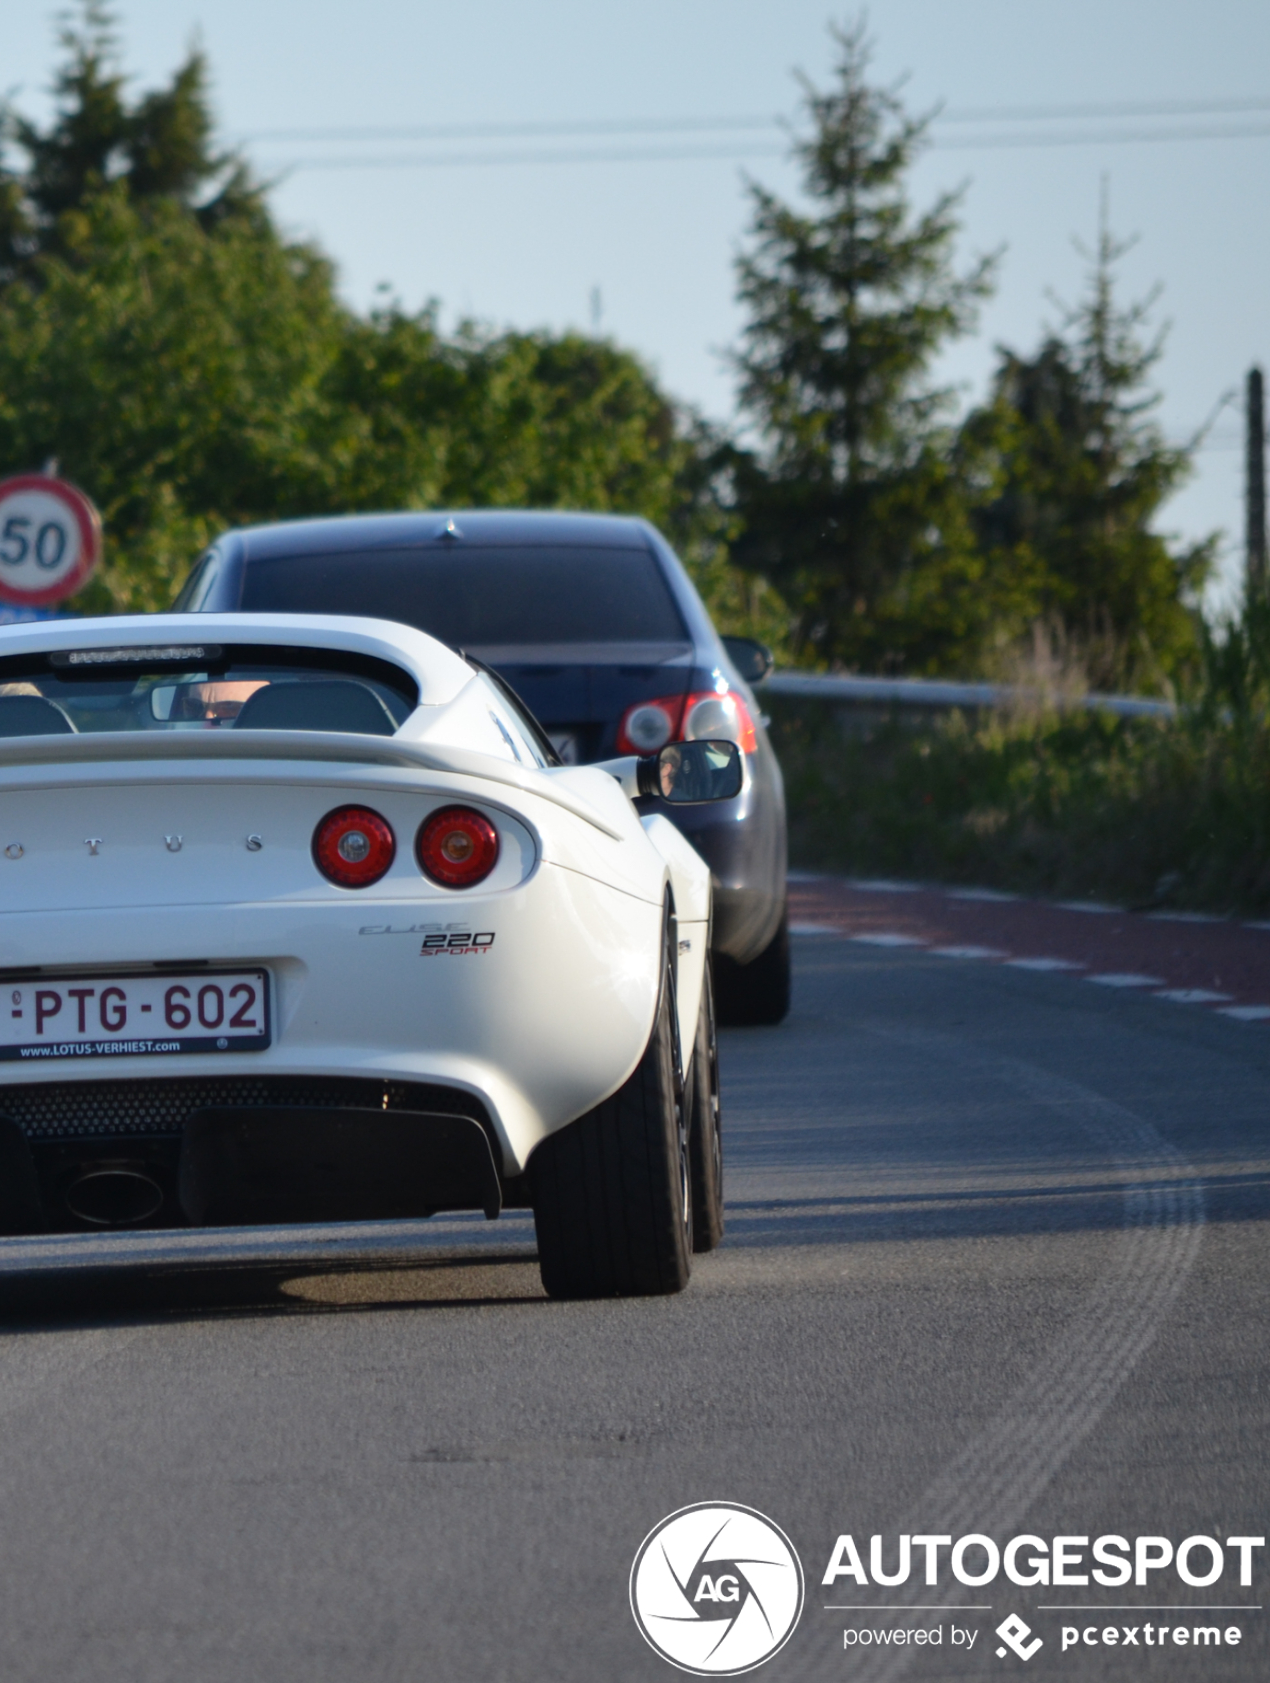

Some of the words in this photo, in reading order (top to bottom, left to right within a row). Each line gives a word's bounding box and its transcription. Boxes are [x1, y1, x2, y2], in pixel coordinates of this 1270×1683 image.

[358, 922, 472, 936] ELISE
[421, 932, 496, 949] 220
[419, 946, 493, 957] SPORT
[20, 1041, 181, 1058] www.LOTUS-VERHIEST.com
